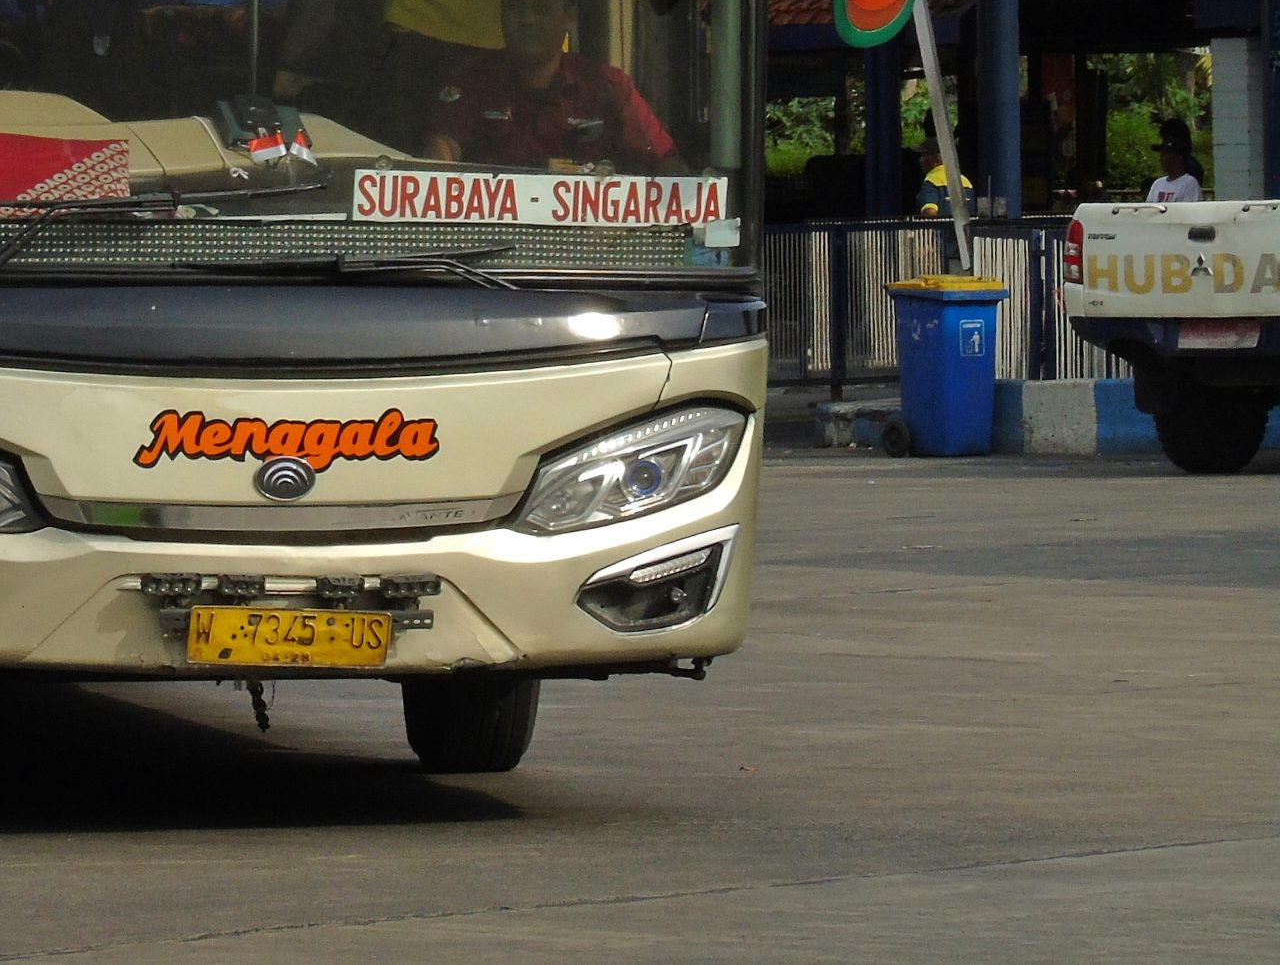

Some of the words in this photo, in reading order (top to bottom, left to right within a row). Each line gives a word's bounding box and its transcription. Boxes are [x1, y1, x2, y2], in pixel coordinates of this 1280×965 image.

[357, 174, 519, 221] SURABAYA
[551, 180, 722, 225] SINGARAJA
[1086, 253, 1193, 295] HUB
[133, 408, 440, 472] Menggala
[196, 612, 214, 645] W
[249, 613, 318, 646] 7345
[351, 617, 384, 650] US
